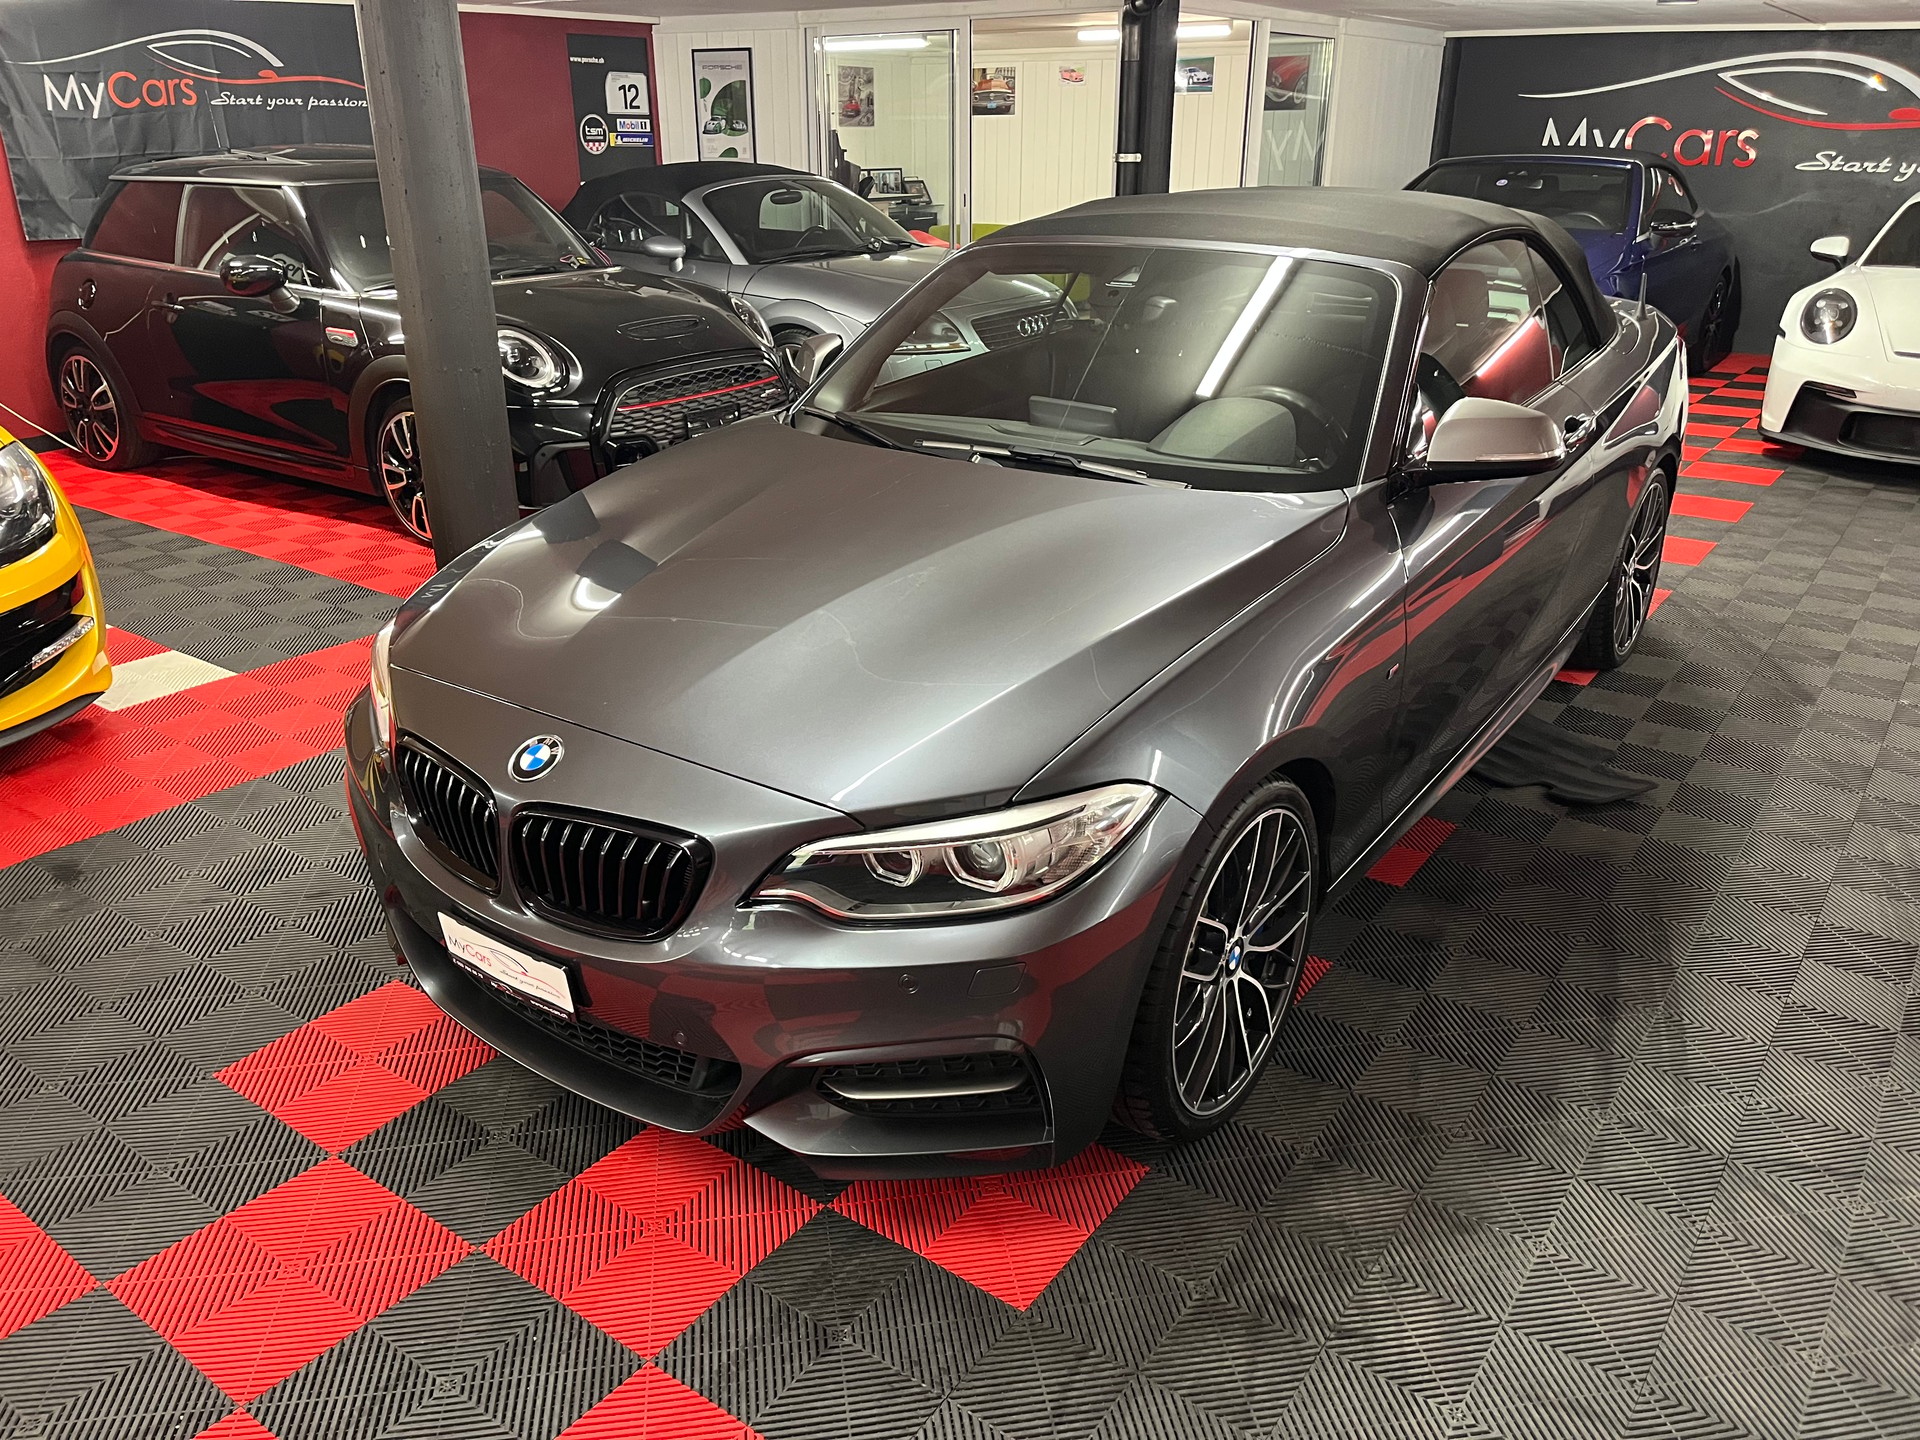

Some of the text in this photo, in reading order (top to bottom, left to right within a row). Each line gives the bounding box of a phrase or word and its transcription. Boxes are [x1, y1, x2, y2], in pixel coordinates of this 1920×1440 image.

[43, 71, 198, 119] MyCars
[210, 91, 368, 111] Start your passion
[618, 83, 641, 110] 12
[585, 125, 603, 135] tsm
[619, 121, 640, 130] Mobil
[1794, 151, 1893, 173] Start
[449, 936, 492, 967] MyCars
